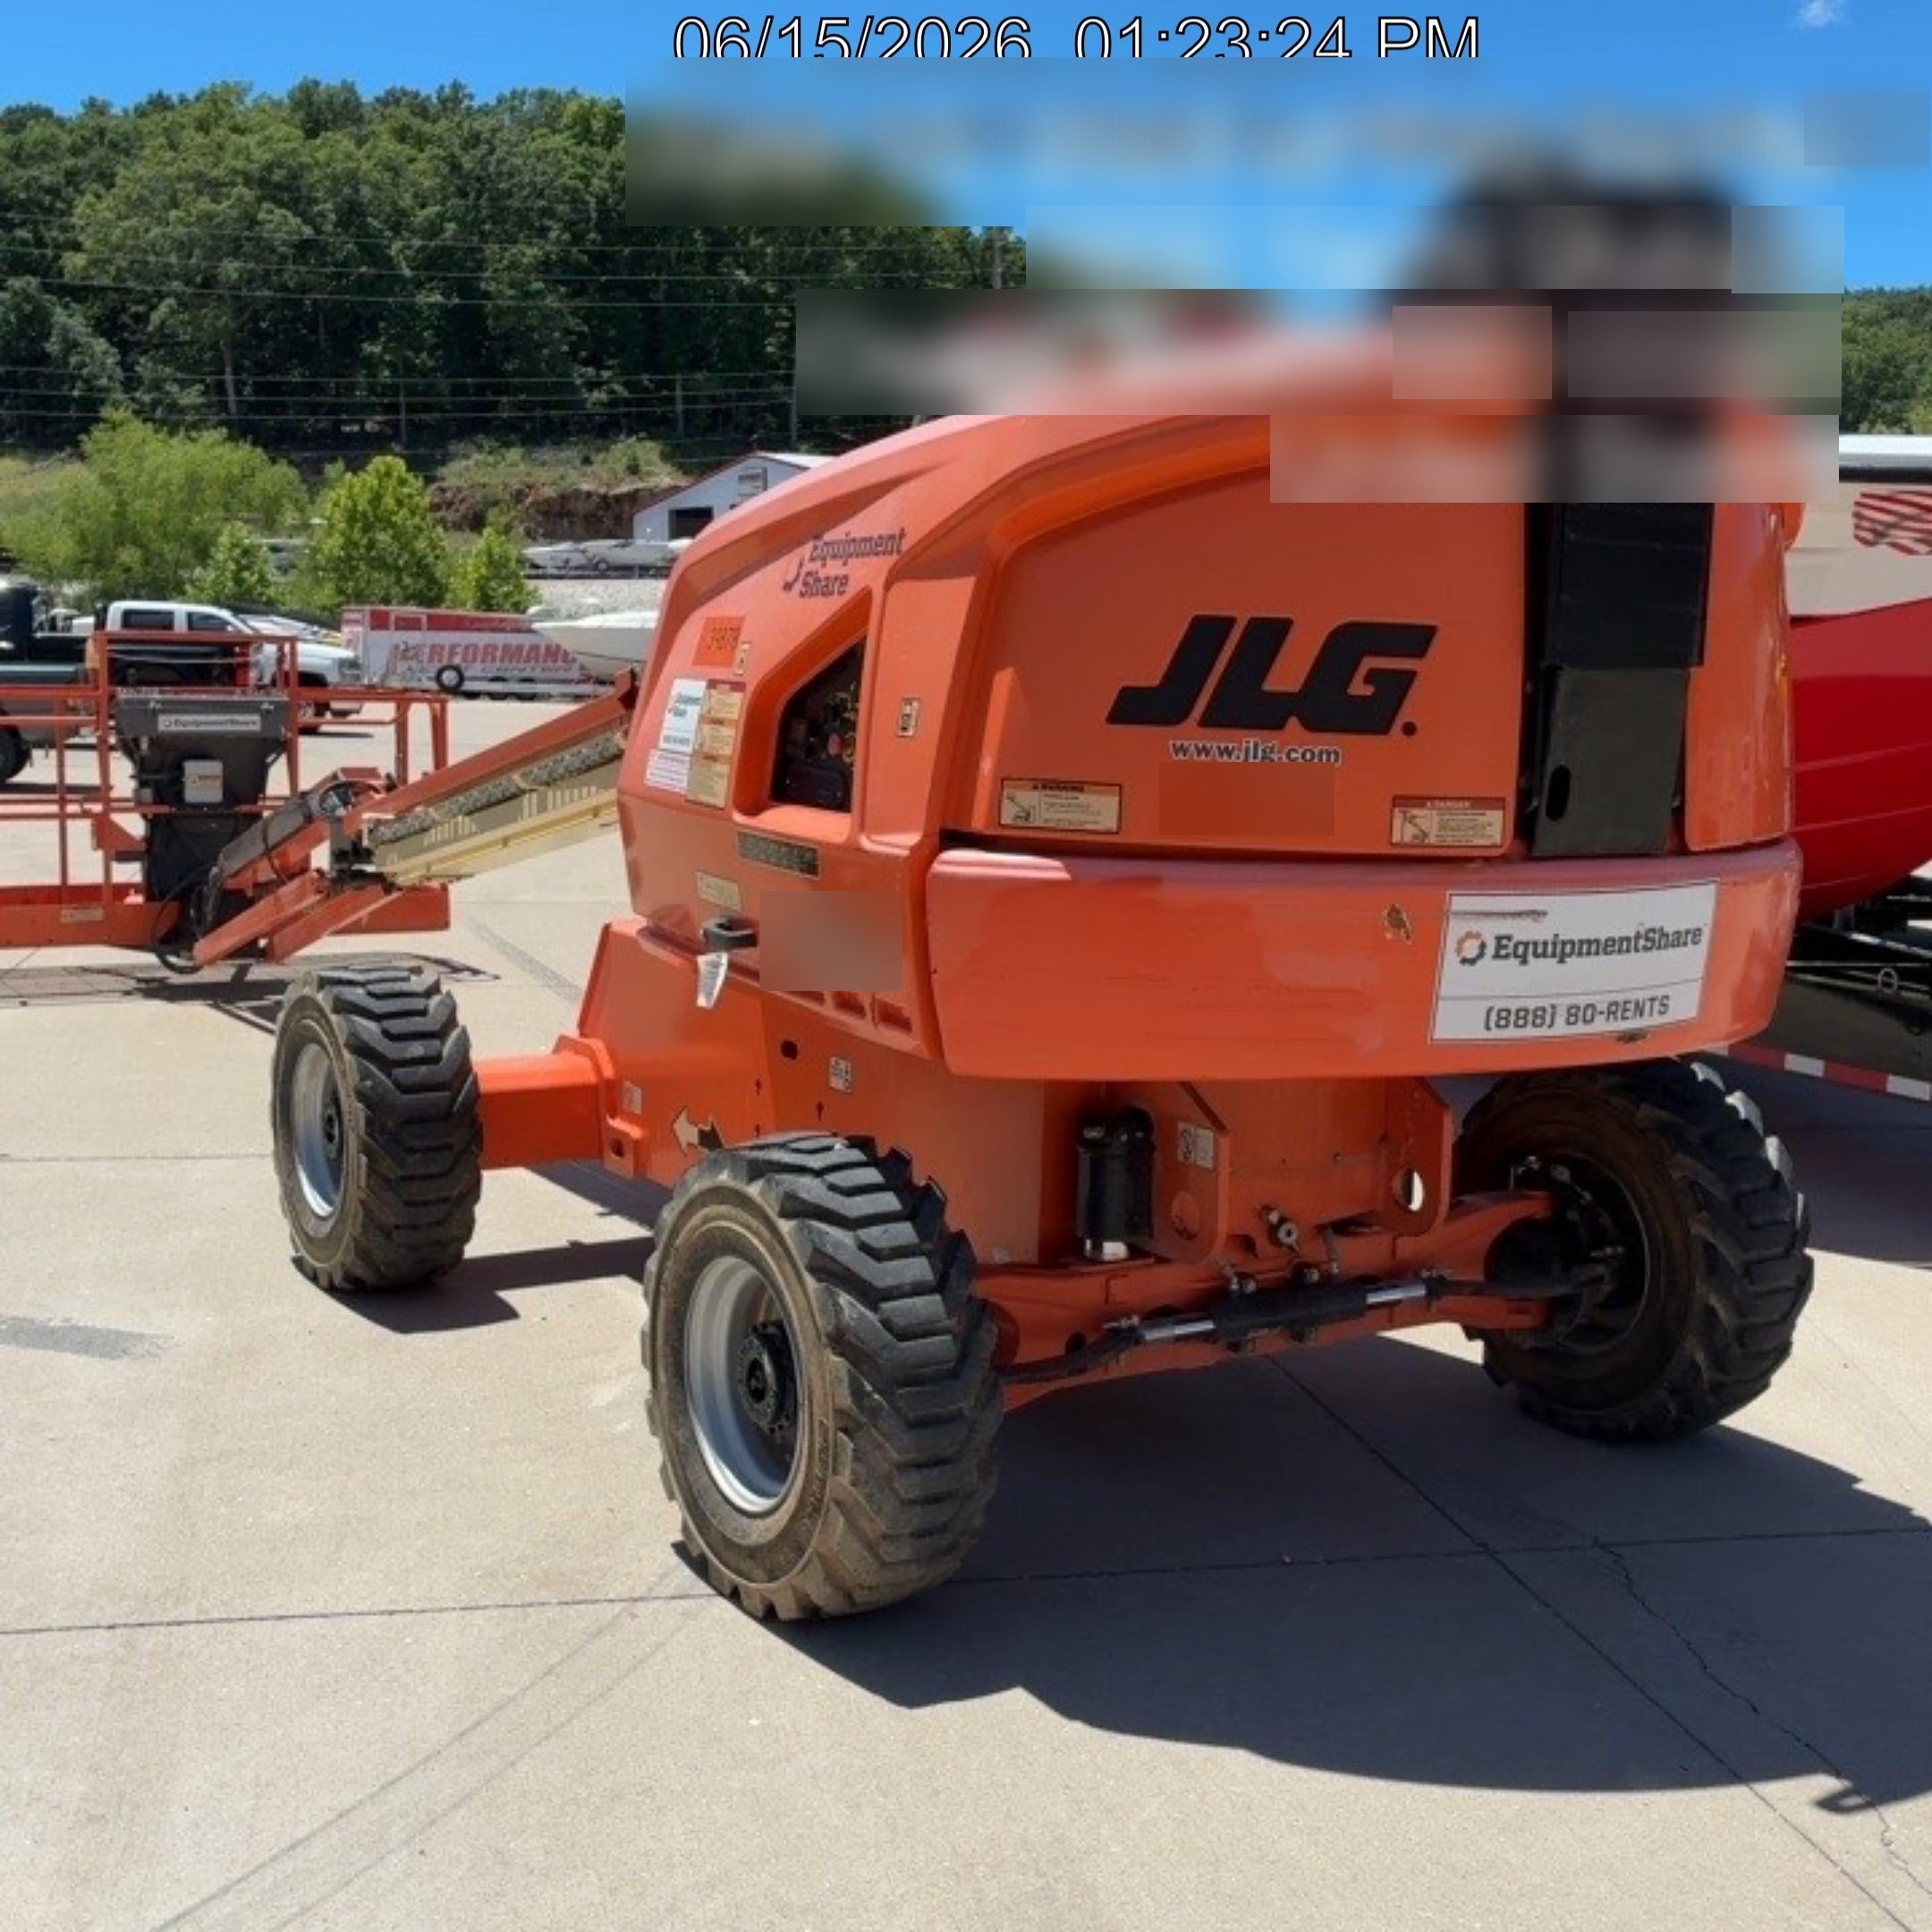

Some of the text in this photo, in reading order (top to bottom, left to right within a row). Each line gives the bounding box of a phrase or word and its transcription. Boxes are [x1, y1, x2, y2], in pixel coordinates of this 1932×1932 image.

[809, 528, 907, 568] Equipment
[800, 571, 849, 597] Share
[1170, 738, 1342, 763] www.jlg.com
[1491, 926, 1702, 966] EquipmentShare
[1484, 995, 1670, 1031] (888) 80-RENTS
